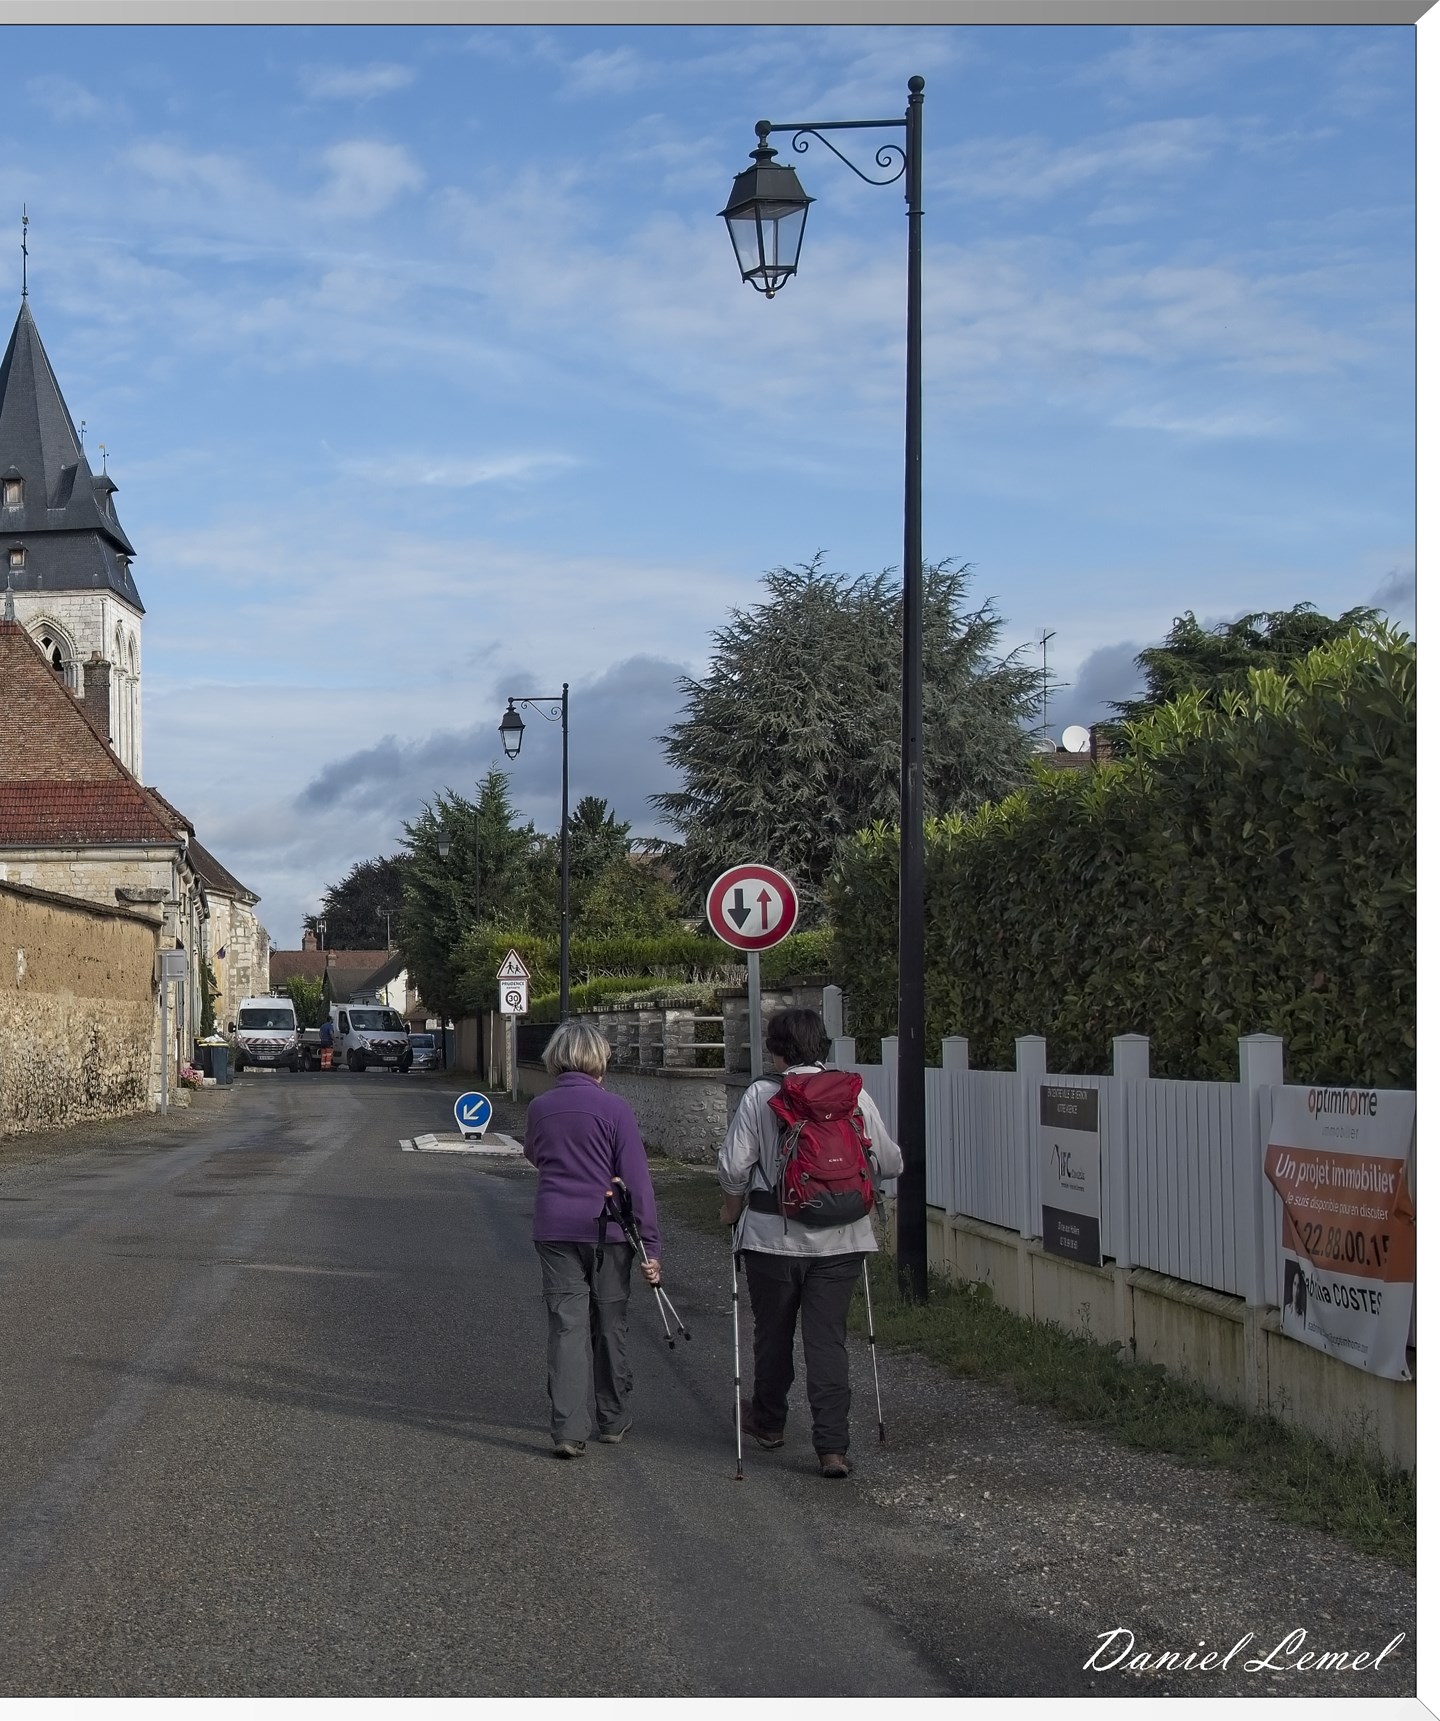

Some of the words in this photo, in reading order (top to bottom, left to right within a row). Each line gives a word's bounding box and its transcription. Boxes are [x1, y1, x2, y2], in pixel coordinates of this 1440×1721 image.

[1308, 1087, 1378, 1121] optimhome
[1275, 1153, 1296, 1180] Un
[1295, 1157, 1330, 1189] projet
[1332, 1160, 1395, 1194] immobilier
[1284, 1191, 1294, 1205] Je
[1294, 1194, 1310, 1208] suis
[1360, 1203, 1389, 1221] discuter
